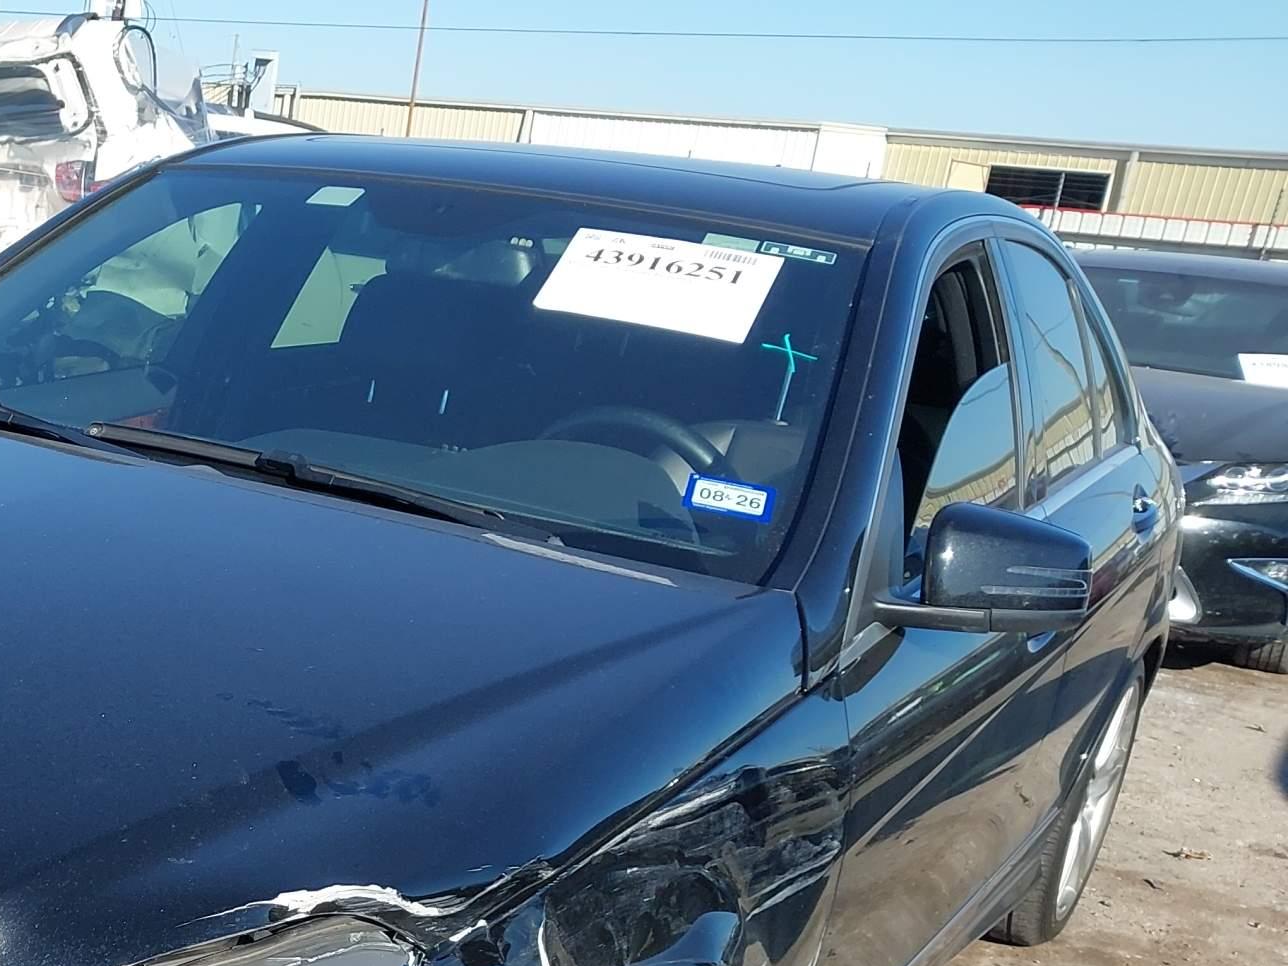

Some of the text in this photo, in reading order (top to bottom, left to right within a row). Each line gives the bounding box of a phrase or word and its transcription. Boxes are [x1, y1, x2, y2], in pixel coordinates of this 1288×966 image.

[585, 248, 743, 285] 43916251
[699, 487, 725, 502] 08
[735, 494, 762, 509] 26
